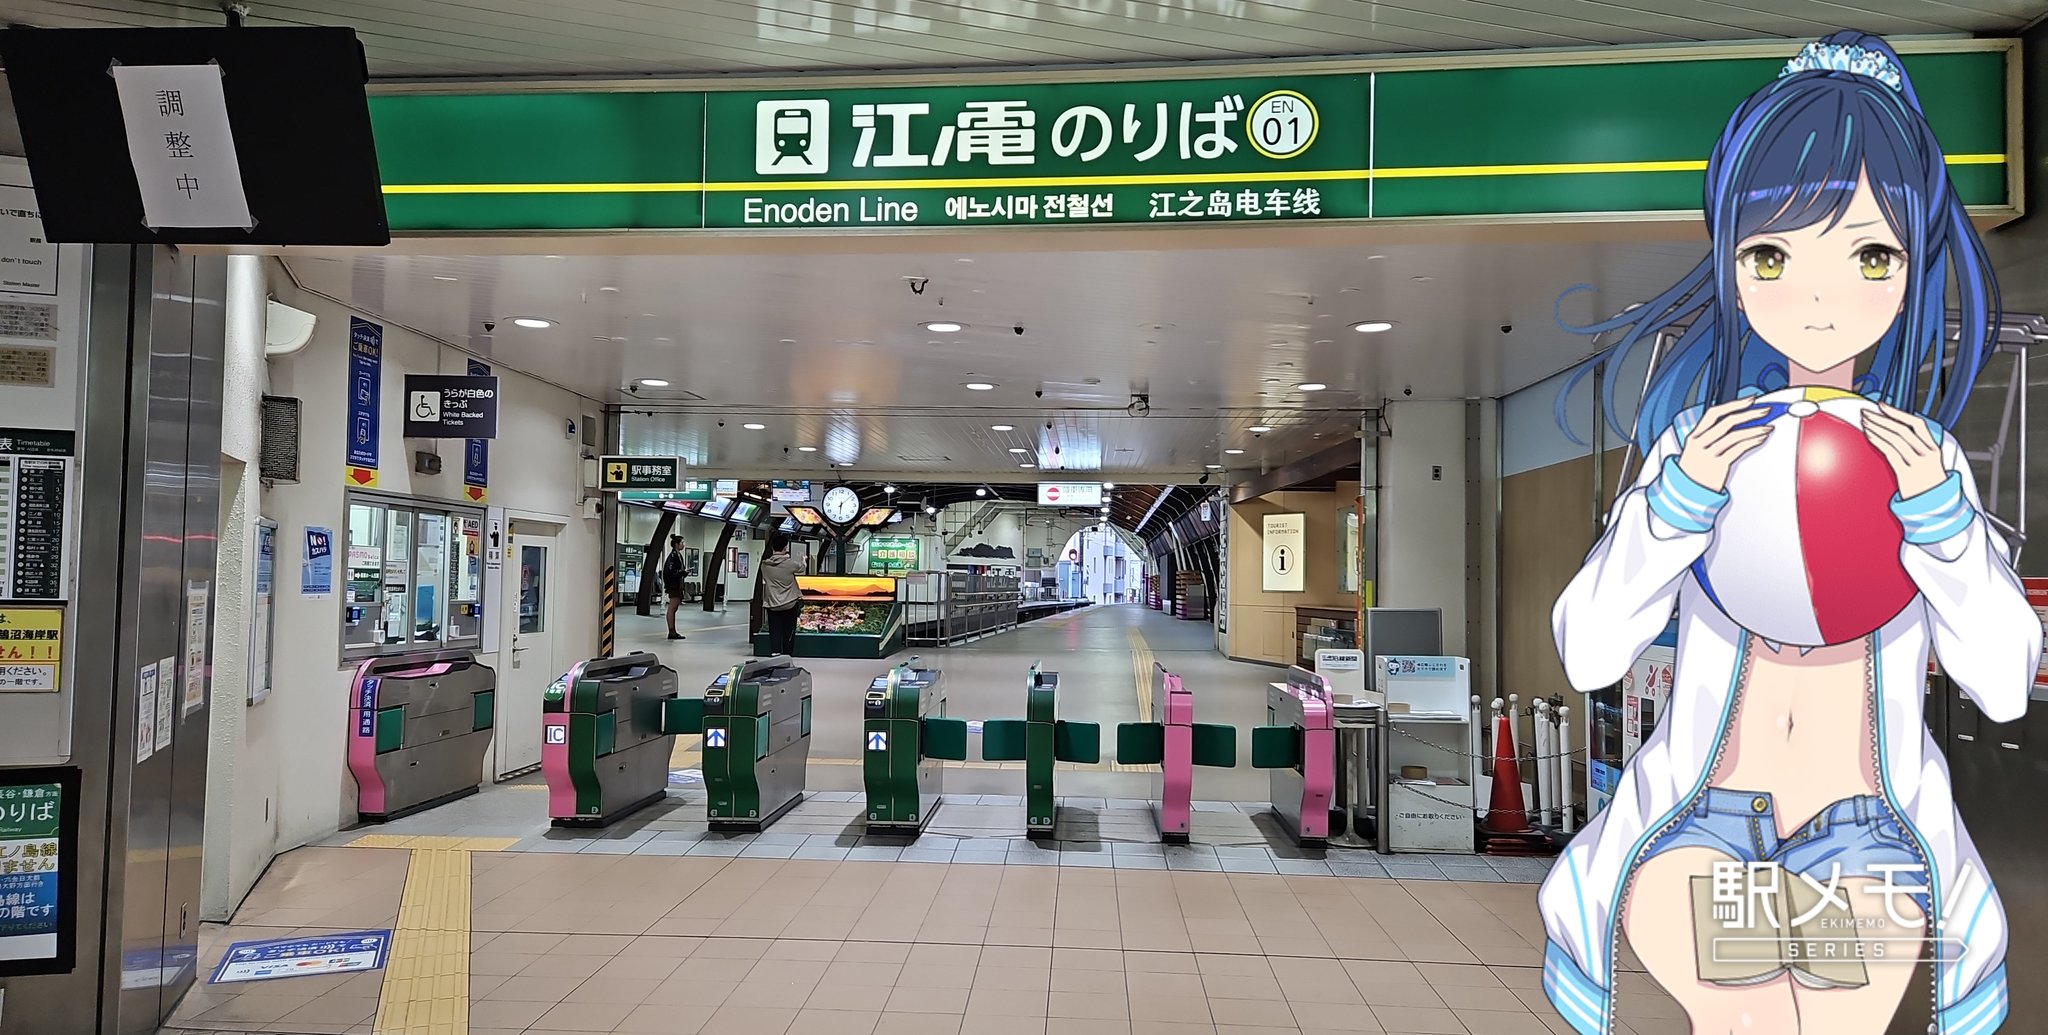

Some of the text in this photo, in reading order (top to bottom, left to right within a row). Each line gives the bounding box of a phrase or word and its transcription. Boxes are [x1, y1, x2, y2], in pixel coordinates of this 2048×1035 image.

[1271, 100, 1294, 113] EN
[1051, 94, 1245, 162] のりば
[1263, 117, 1298, 146] 01
[155, 89, 199, 200] 調整中
[744, 196, 918, 223] Enoden Line
[944, 192, 1113, 220] 에노시마 전철선
[1149, 188, 1321, 218] 江之岛电车线
[443, 388, 494, 399] うらが白色の
[443, 400, 468, 409] きっぷ
[460, 411, 484, 419] Backed
[631, 465, 672, 476] 駅事務室
[467, 520, 478, 529] AED
[549, 728, 563, 741] IC
[0, 801, 55, 823] りば
